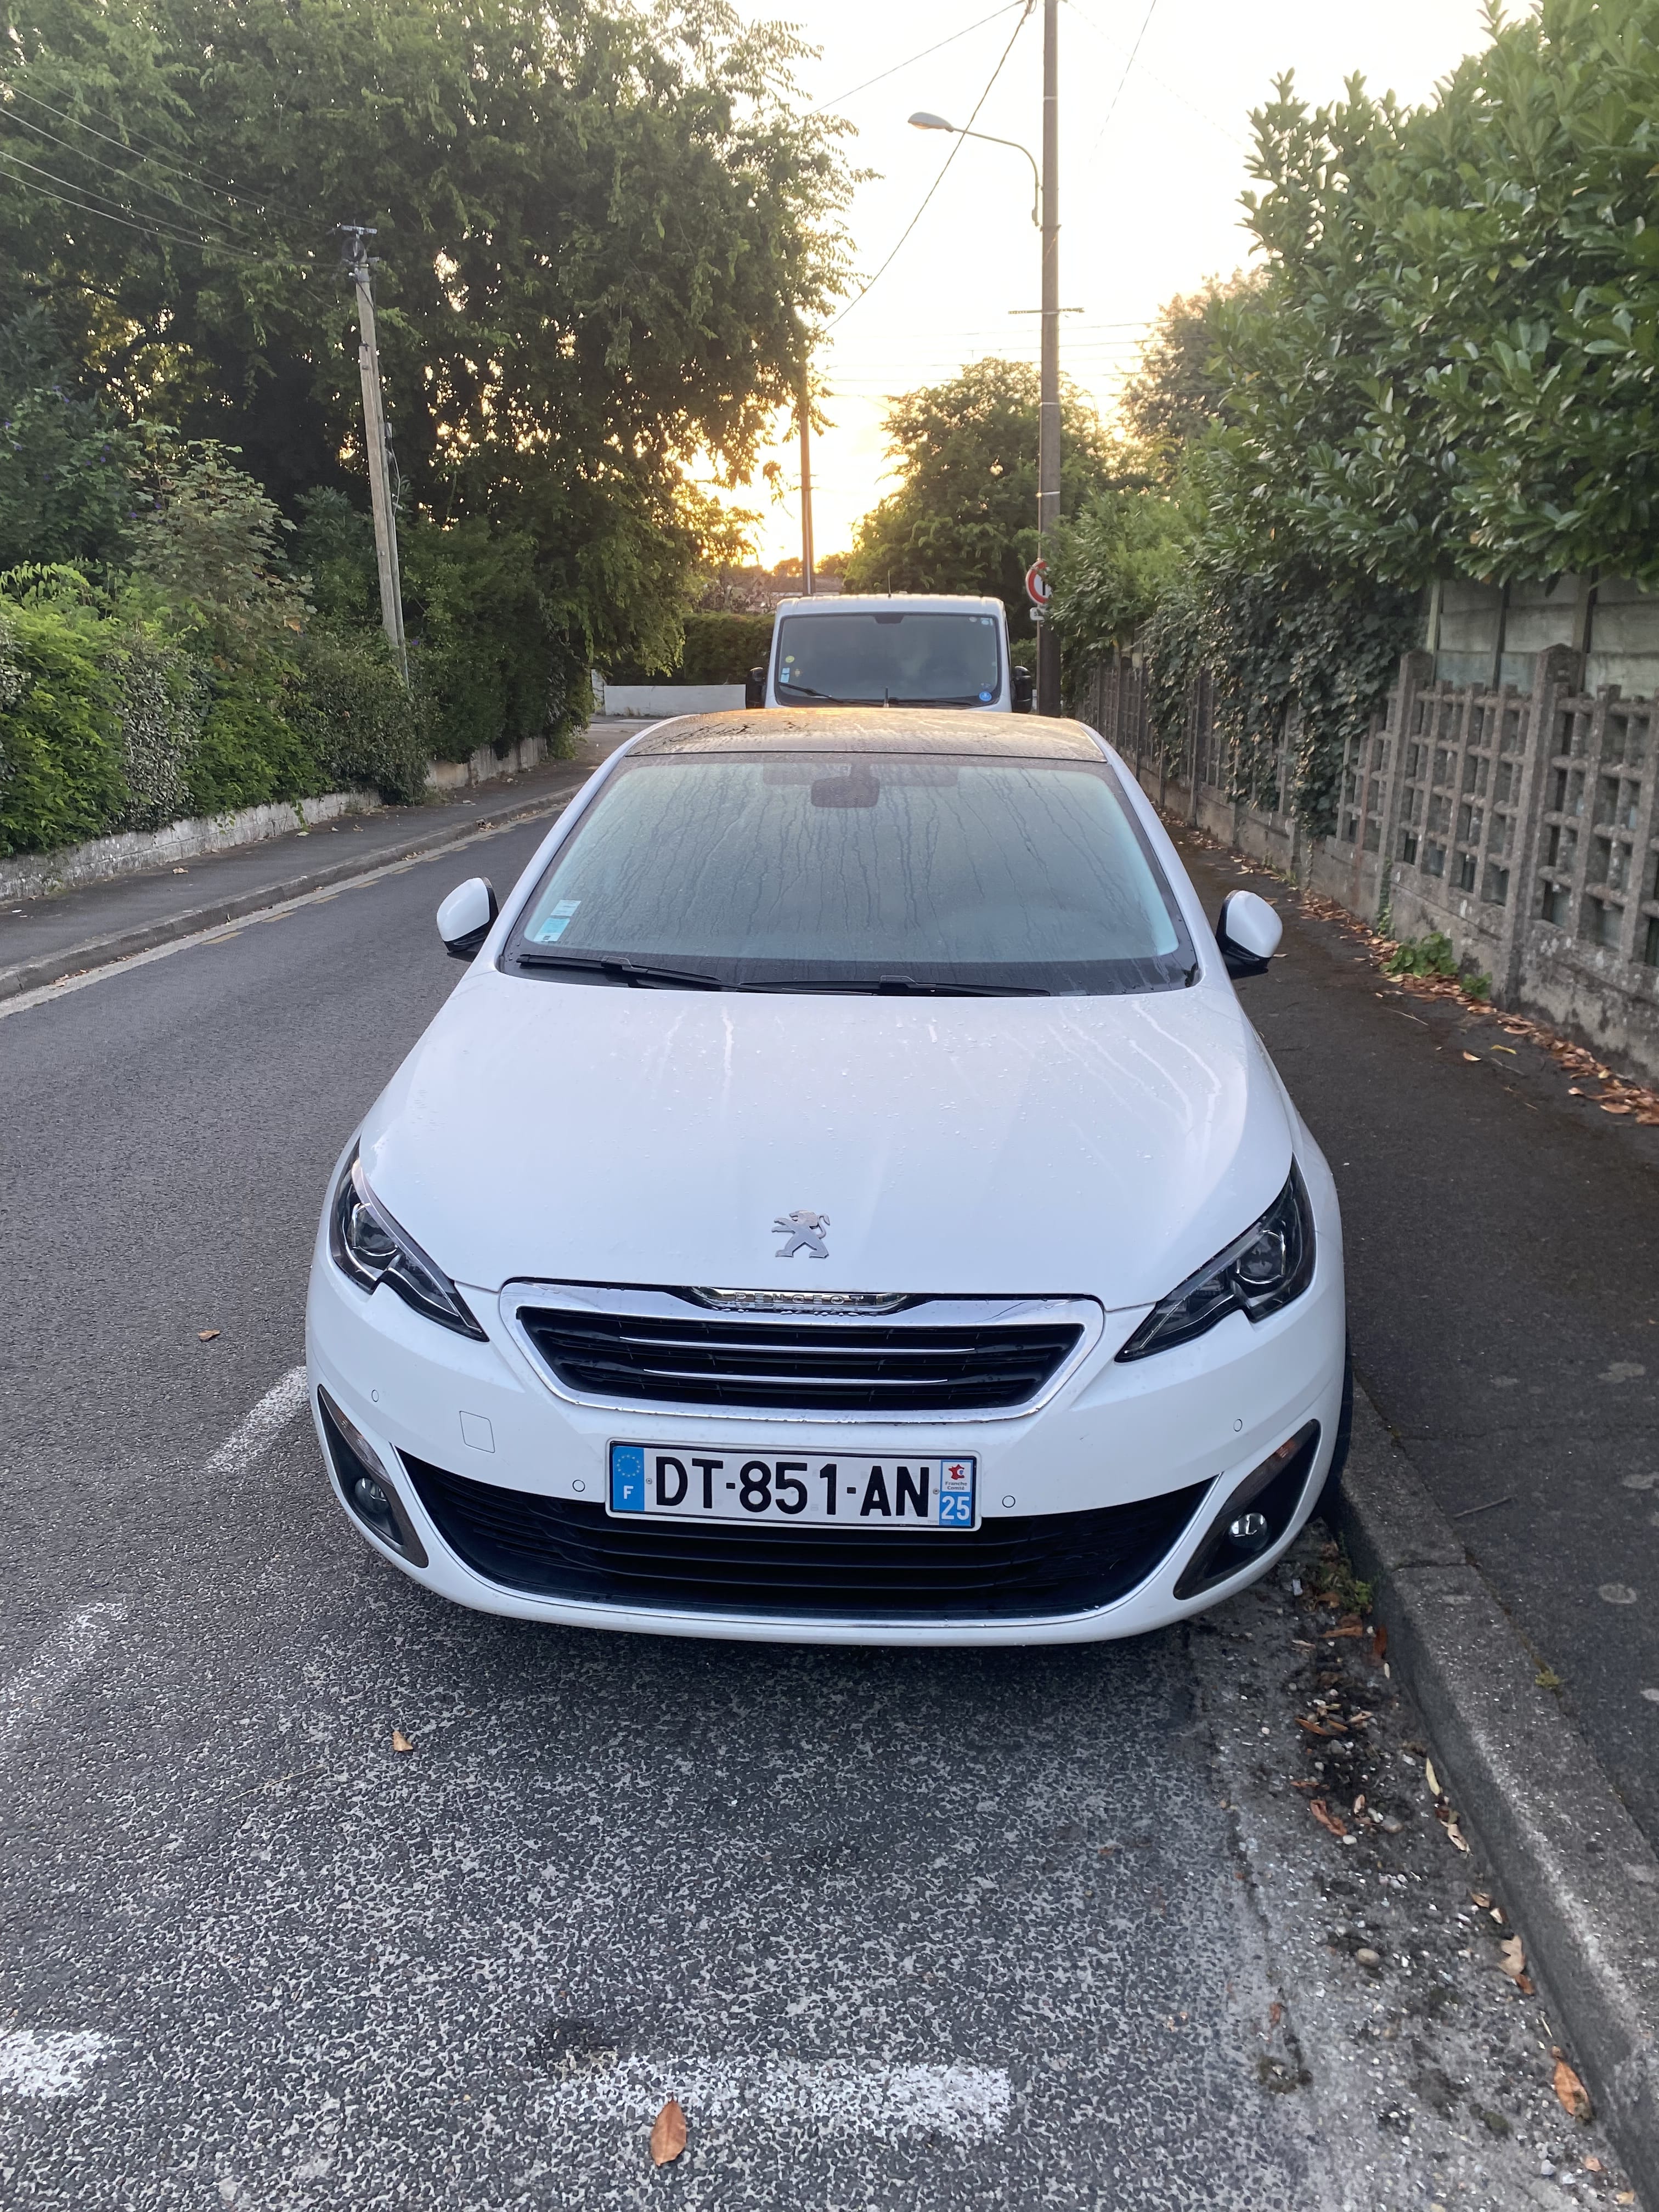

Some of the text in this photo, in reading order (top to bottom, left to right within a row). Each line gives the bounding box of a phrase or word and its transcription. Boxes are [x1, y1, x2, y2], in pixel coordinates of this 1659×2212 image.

[735, 1292, 864, 1305] PEUGEOT
[623, 1485, 634, 1499] F
[656, 1456, 929, 1517] DT-851-AN
[941, 1496, 970, 1520] 25
